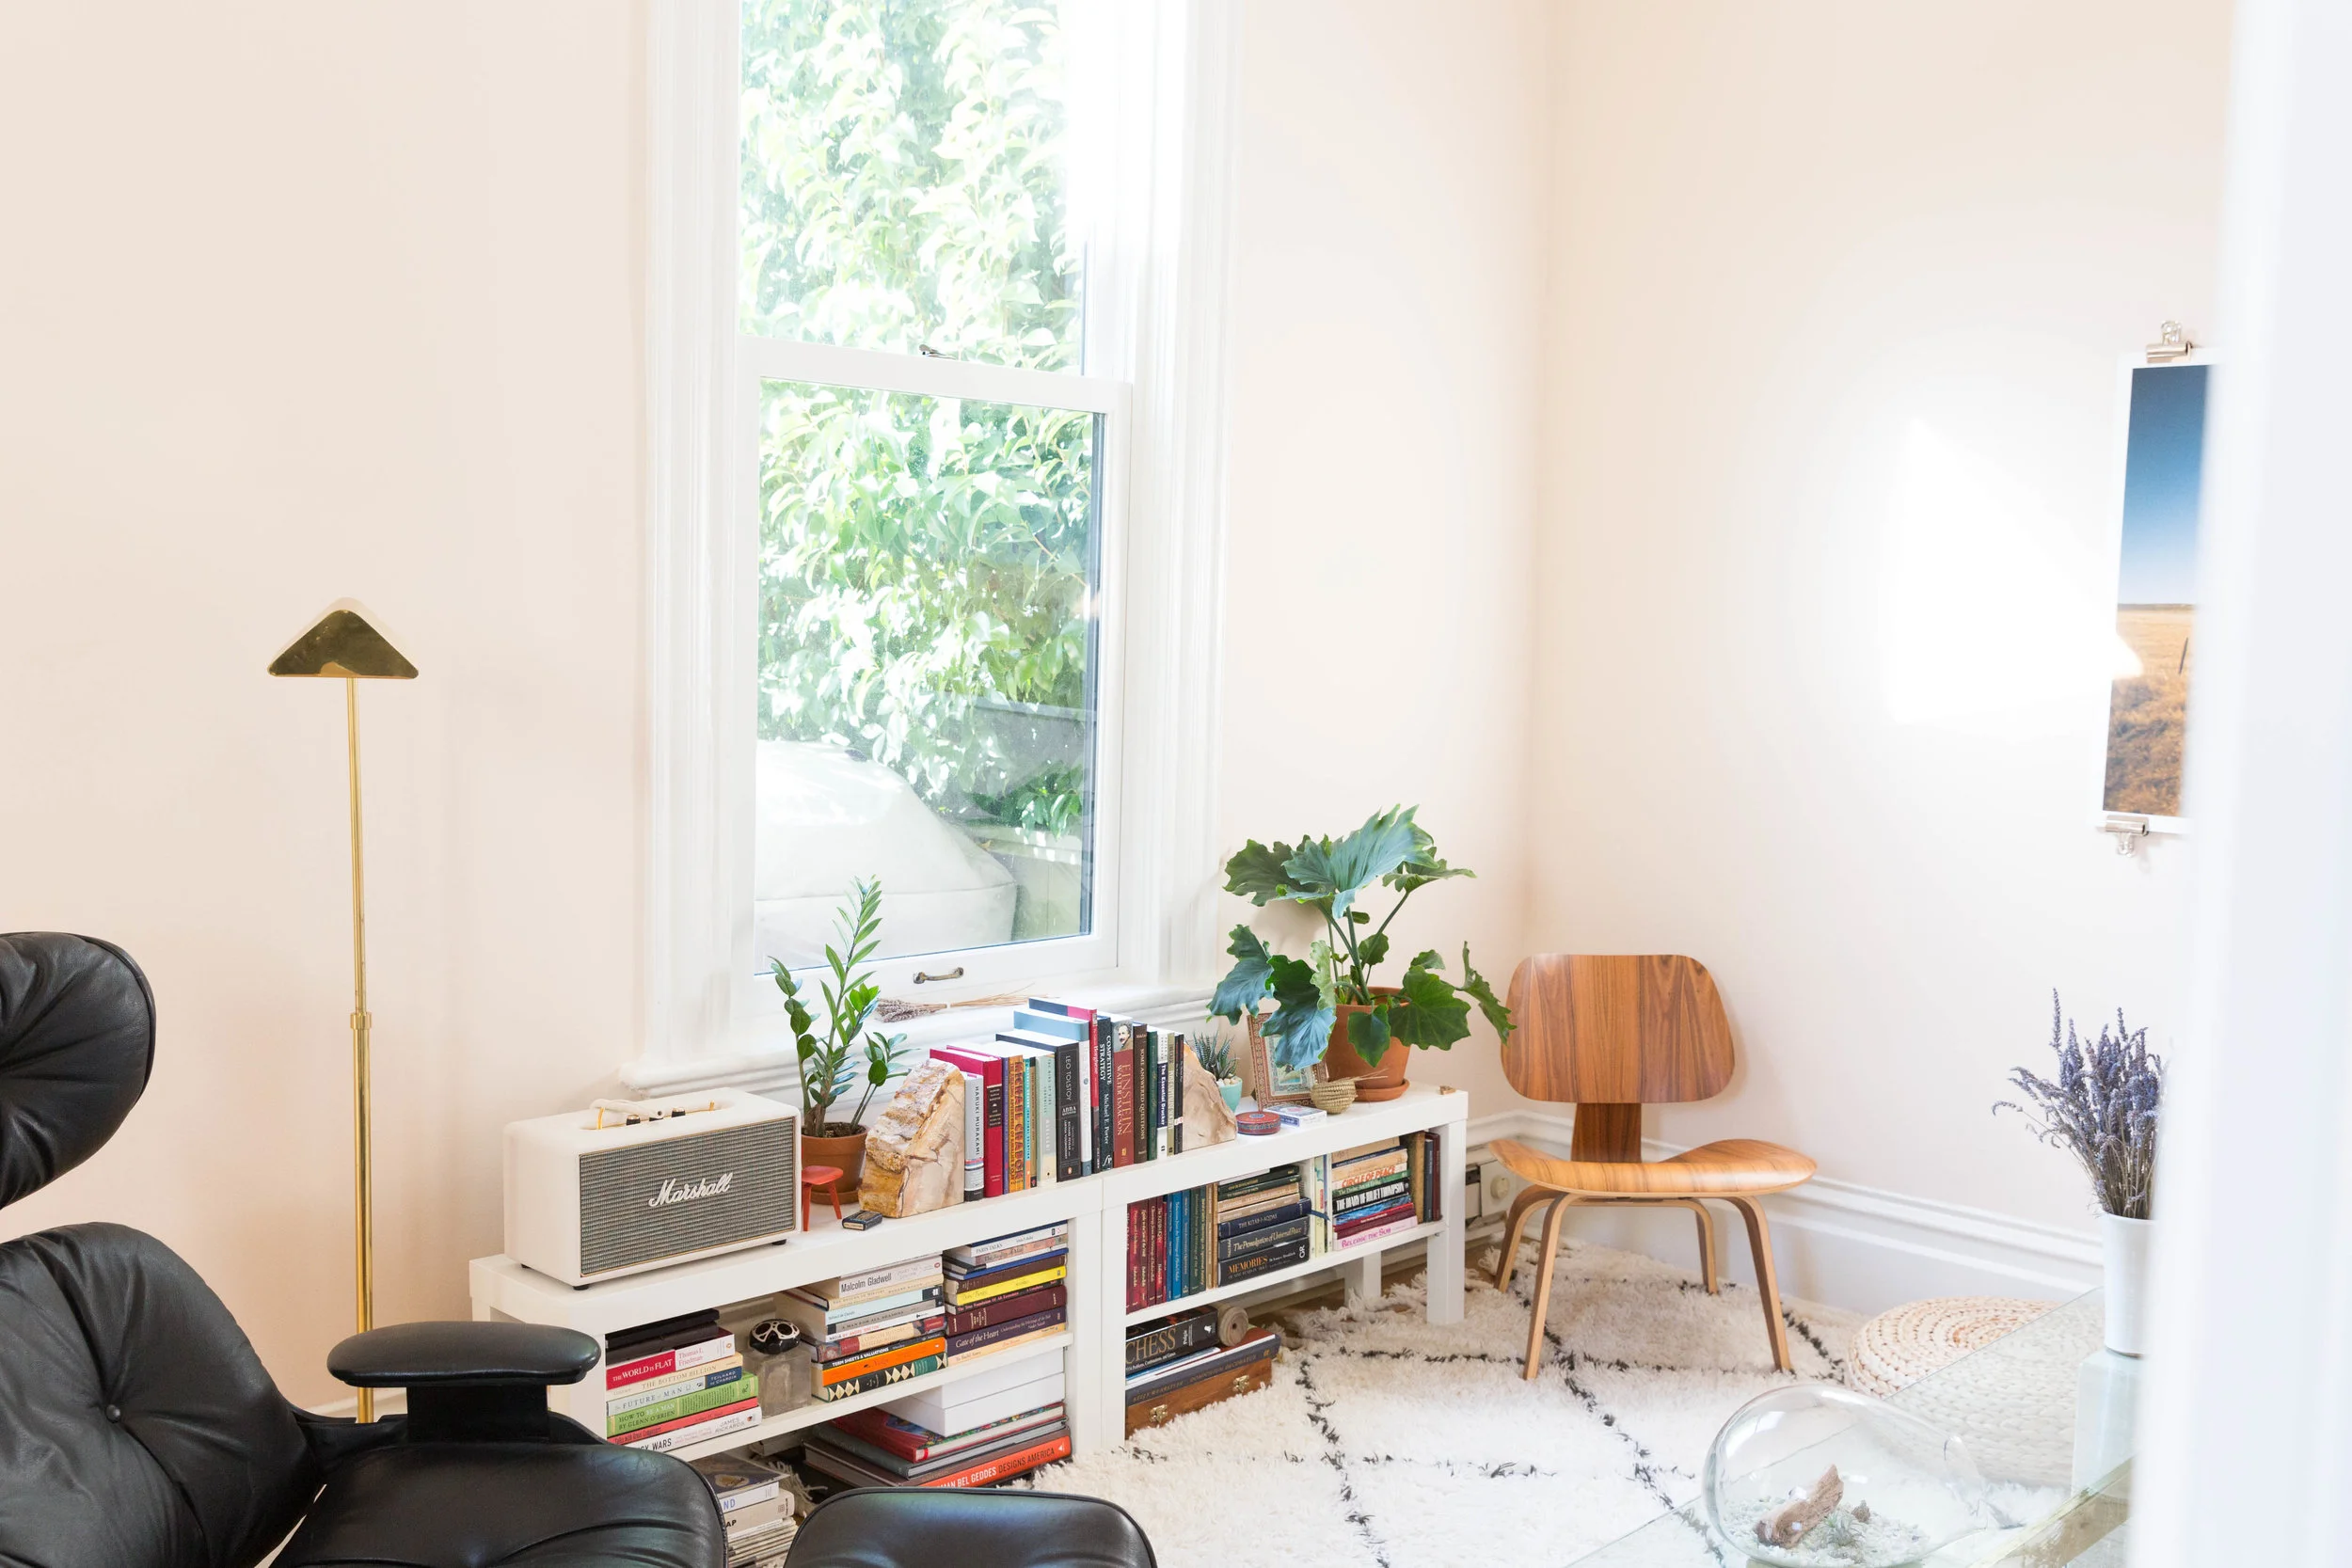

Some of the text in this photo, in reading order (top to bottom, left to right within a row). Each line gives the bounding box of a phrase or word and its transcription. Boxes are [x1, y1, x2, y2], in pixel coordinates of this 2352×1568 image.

[1015, 1061, 1024, 1119] MICHAEL
[1121, 1064, 1131, 1134] EINSTEIN
[1342, 1165, 1396, 1188] CIRCLE OF PEACE
[648, 1172, 733, 1207] Marshall
[1228, 1257, 1268, 1274] MEMORIES
[841, 1280, 866, 1293] Malcolm
[867, 1273, 892, 1286] Gladwell
[955, 1338, 969, 1348] Gate
[983, 1330, 1000, 1340] Heart
[1125, 1327, 1176, 1364] CHESS
[678, 1349, 698, 1360] Thomas
[678, 1355, 704, 1367] Friedman
[845, 1355, 860, 1364] SHEETS
[864, 1347, 889, 1358] VALUATIONS
[612, 1374, 622, 1383] THE
[622, 1366, 649, 1379] WORLD
[654, 1359, 673, 1370] FLAT
[642, 1366, 717, 1390] THE BOTTOM BILLION
[623, 1387, 683, 1409] FUTURE MAN
[619, 1414, 634, 1422] HOW
[628, 1418, 649, 1428] GLENN
[652, 1437, 672, 1450] WARS
[957, 1476, 970, 1487] BEL
[970, 1467, 997, 1482] GEDDES
[998, 1457, 1026, 1474] DESIGNS
[1026, 1448, 1056, 1464] AMERICA
